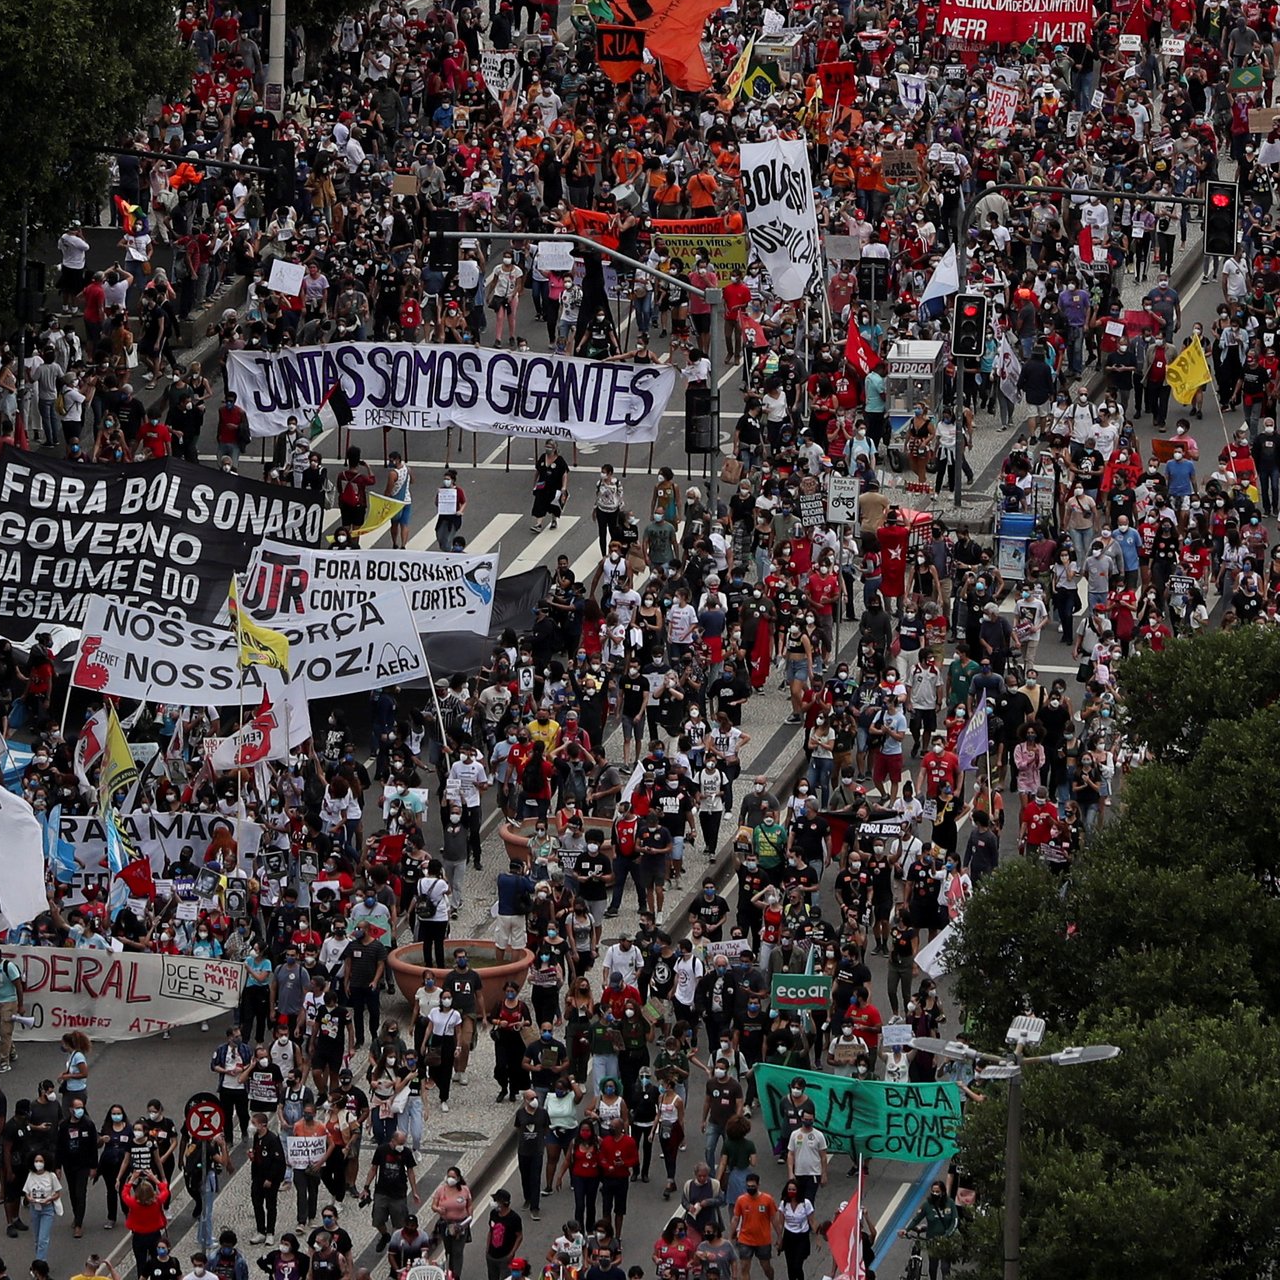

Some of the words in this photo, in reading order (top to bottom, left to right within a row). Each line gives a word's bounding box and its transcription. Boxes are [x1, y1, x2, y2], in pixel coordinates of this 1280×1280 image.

[1012, 0, 1023, 13] DE
[941, 16, 988, 41] MEPR
[600, 31, 642, 56] RUA
[696, 239, 704, 247] O
[706, 238, 732, 247] VÍRUS
[891, 362, 932, 374] PIPOCA
[252, 345, 365, 413] JUNTAS
[366, 348, 484, 409] SOMOS
[484, 352, 661, 427] GIGANTES
[364, 408, 431, 428] PRESENTE
[0, 461, 108, 515] FORA
[119, 470, 323, 544] BOLSONARO
[29, 555, 129, 592] FOME
[132, 559, 157, 594] E
[159, 566, 201, 605] DO
[313, 557, 362, 581] FORA
[365, 559, 464, 583] BOLSONARO
[411, 585, 467, 612] CORTES
[102, 604, 242, 653] NOSSA
[94, 648, 119, 669] FENET
[375, 654, 421, 680] AERJ
[123, 652, 263, 691] NOSSA
[858, 823, 880, 834] FORA
[881, 823, 901, 835] BOZO
[166, 962, 200, 981] DCE
[204, 961, 240, 980] MÁRIO
[167, 980, 226, 1003] UFRJ
[204, 972, 240, 992] PRATA
[776, 984, 828, 1000] ecoar
[884, 1087, 953, 1112] BALA
[885, 1112, 961, 1142] FOME
[865, 1134, 945, 1158] COVID
